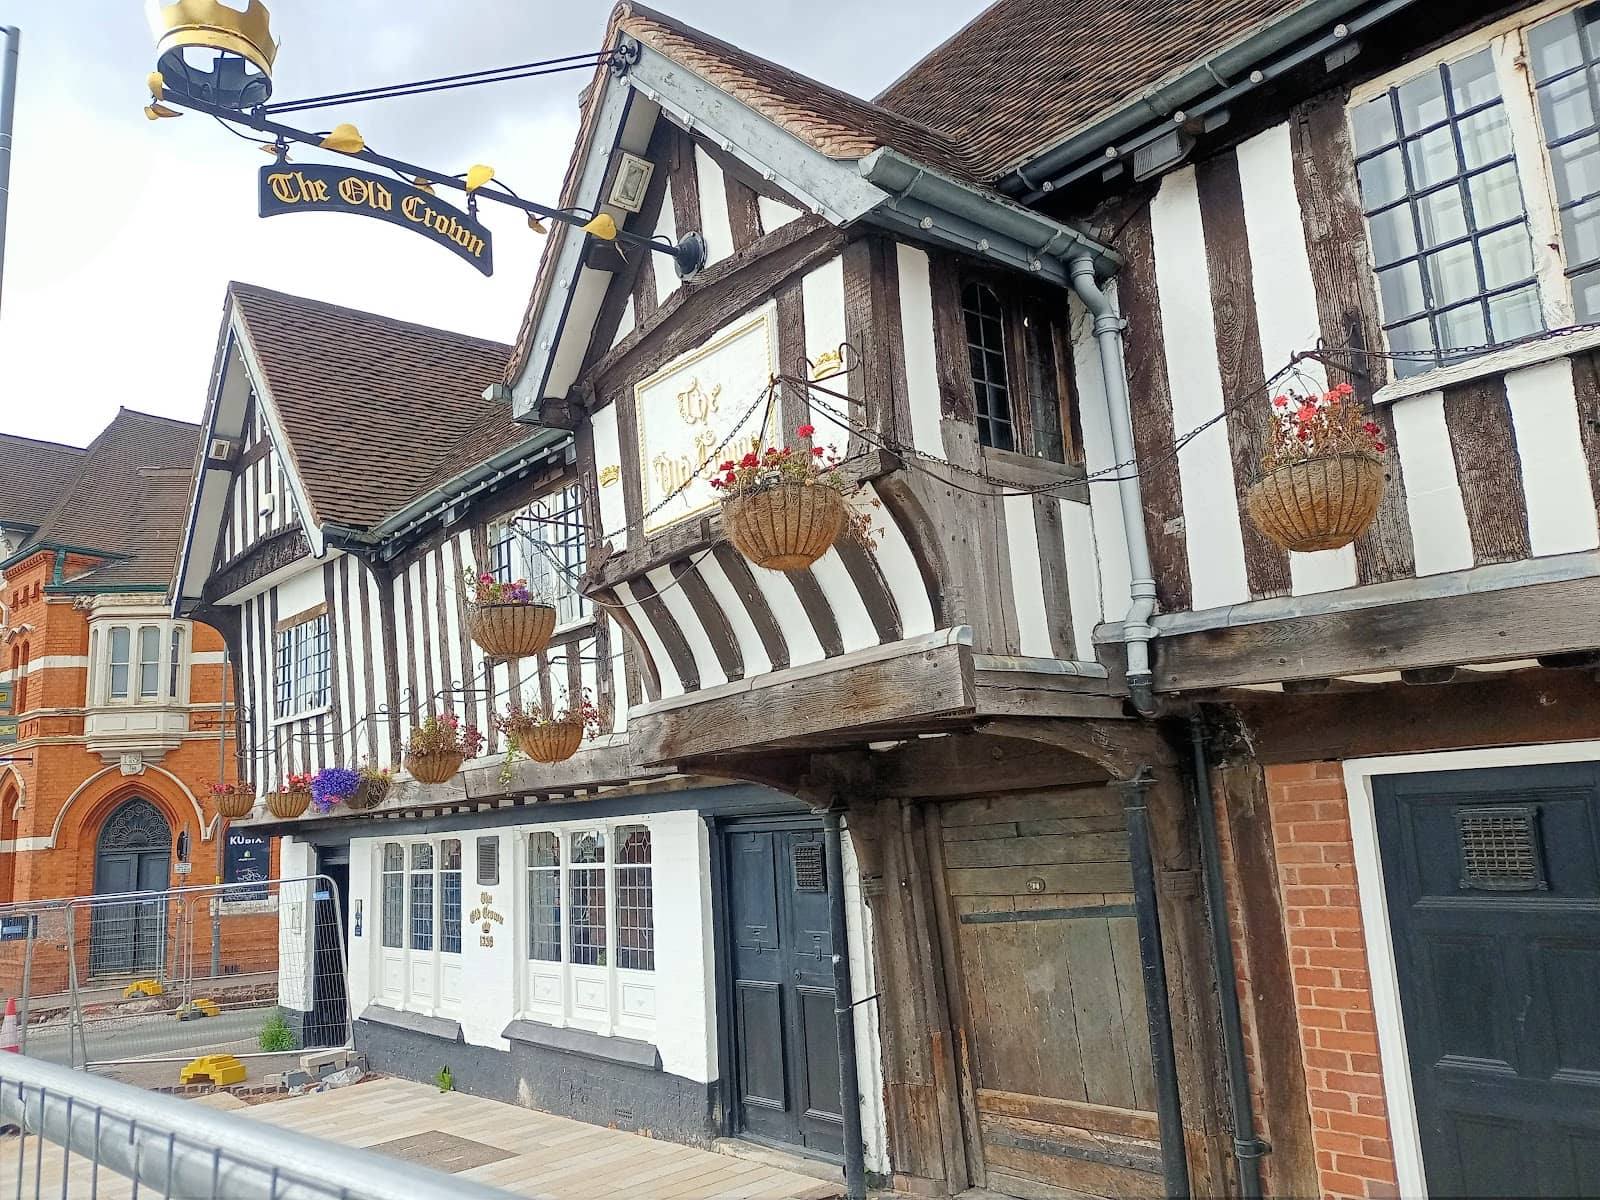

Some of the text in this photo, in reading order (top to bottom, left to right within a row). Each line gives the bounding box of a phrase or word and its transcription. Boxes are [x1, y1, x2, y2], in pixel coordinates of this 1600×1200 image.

[267, 171, 486, 258] The Old Crown
[677, 375, 722, 426] The
[482, 905, 504, 925] Crown
